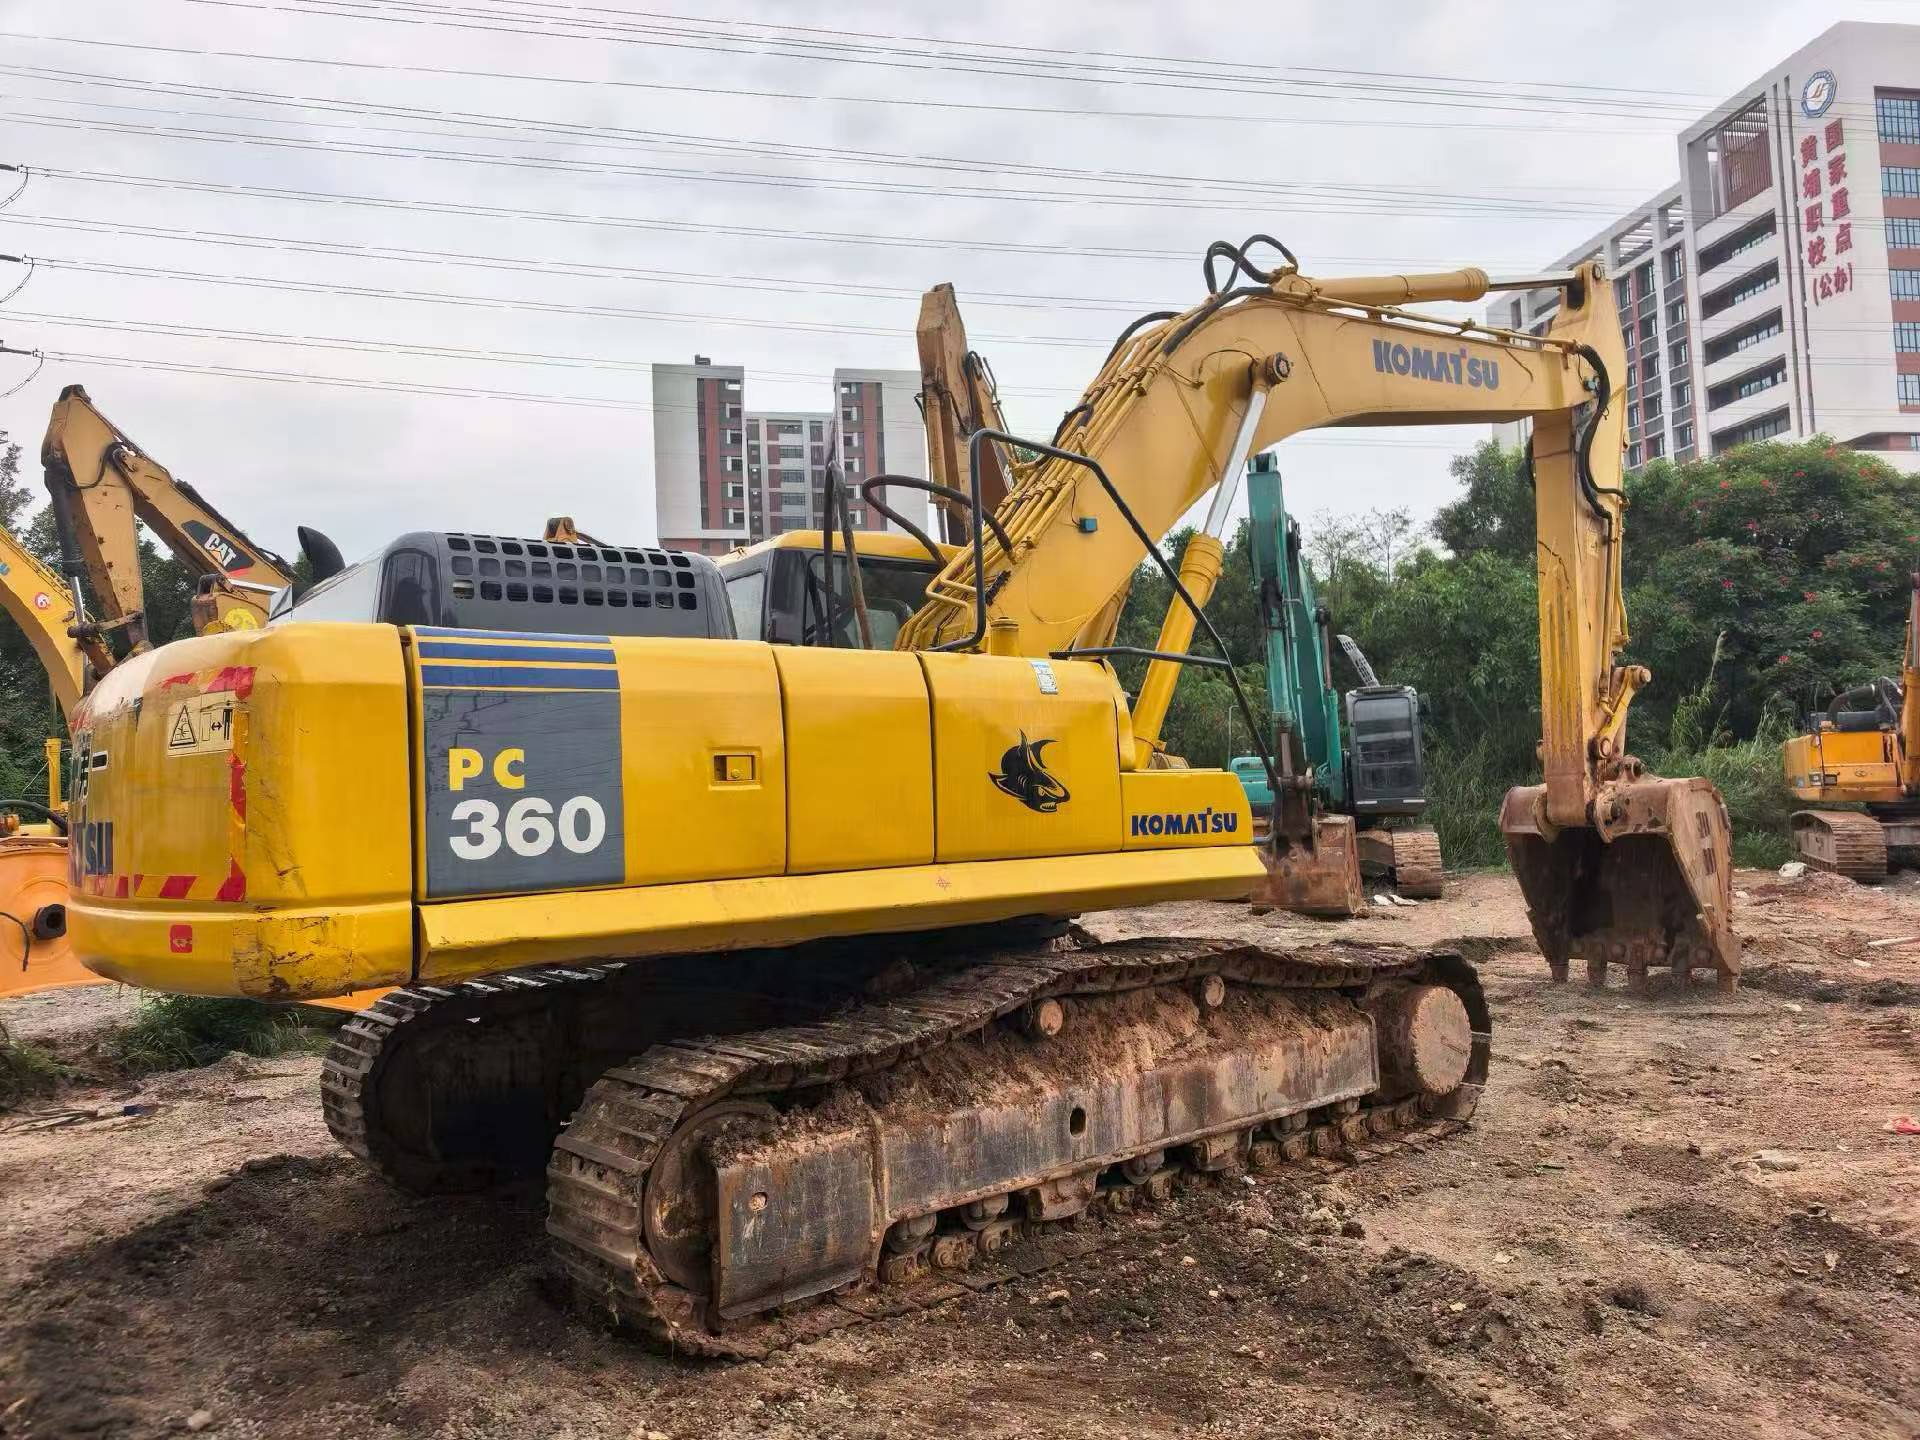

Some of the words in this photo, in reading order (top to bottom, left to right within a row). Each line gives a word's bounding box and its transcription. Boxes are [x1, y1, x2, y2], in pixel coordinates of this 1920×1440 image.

[1825, 118, 1852, 255] 国家重点
[1372, 339, 1499, 391] KOMATSU
[204, 533, 237, 567] CAT
[448, 748, 525, 791] PC
[449, 796, 606, 860] 360
[1131, 808, 1238, 837] KOMATSU
